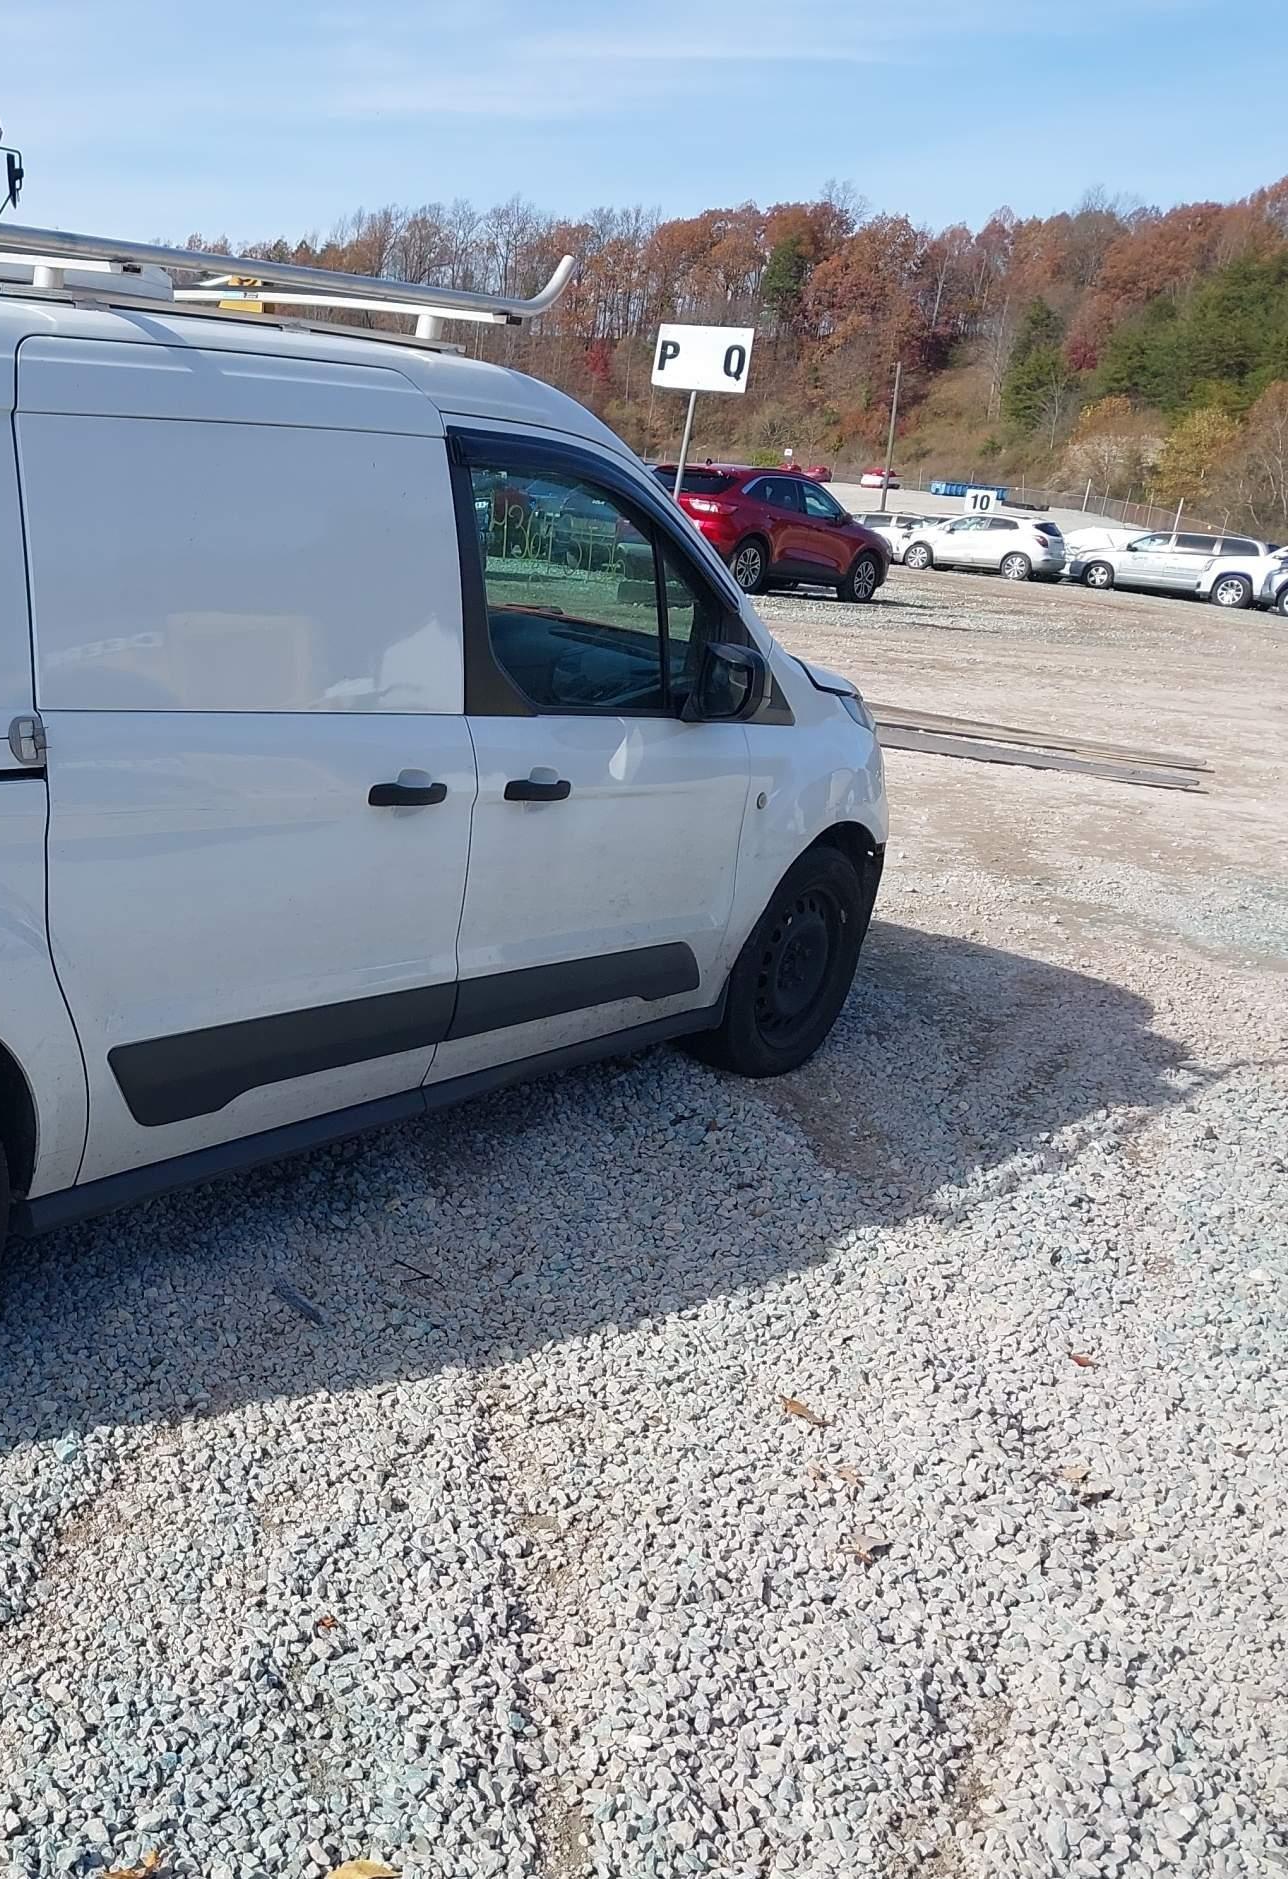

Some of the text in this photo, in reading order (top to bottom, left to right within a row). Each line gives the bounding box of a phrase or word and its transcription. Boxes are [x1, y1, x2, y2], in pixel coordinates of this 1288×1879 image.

[657, 340, 746, 381] P Q
[971, 494, 990, 511] 10
